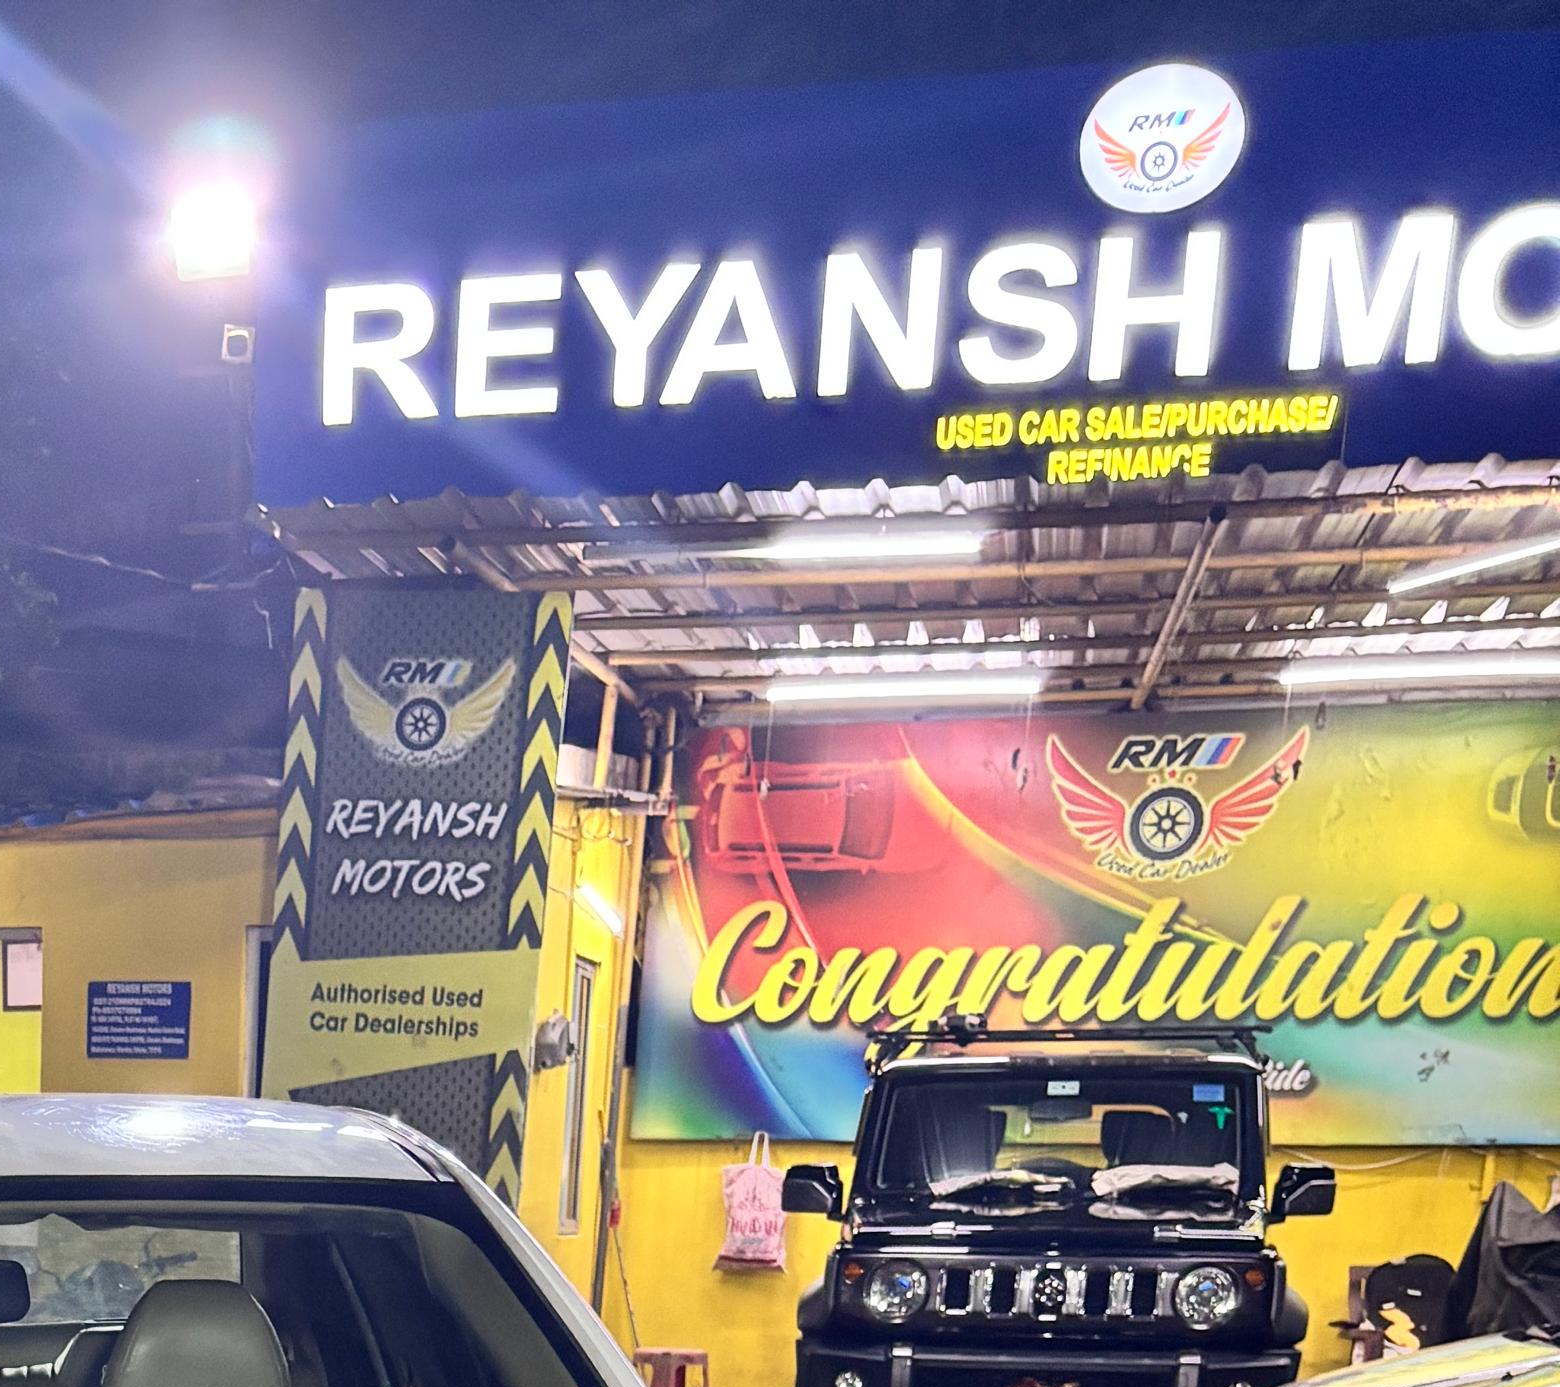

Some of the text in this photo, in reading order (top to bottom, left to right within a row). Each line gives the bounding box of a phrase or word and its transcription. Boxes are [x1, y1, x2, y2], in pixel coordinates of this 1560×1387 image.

[320, 226, 1225, 427] REYANSH
[936, 394, 1339, 450] USED CAR SALE/PURCHASE/
[1047, 443, 1212, 485] REFINANCE
[326, 799, 509, 841] REYANSH
[331, 859, 493, 902] MOTORS
[1139, 861, 1170, 879] Car
[1174, 851, 1229, 879] Dealer
[310, 981, 484, 1009] Authorised Used
[309, 1011, 479, 1039] Car Dealerships
[1263, 1059, 1312, 1091] ide
